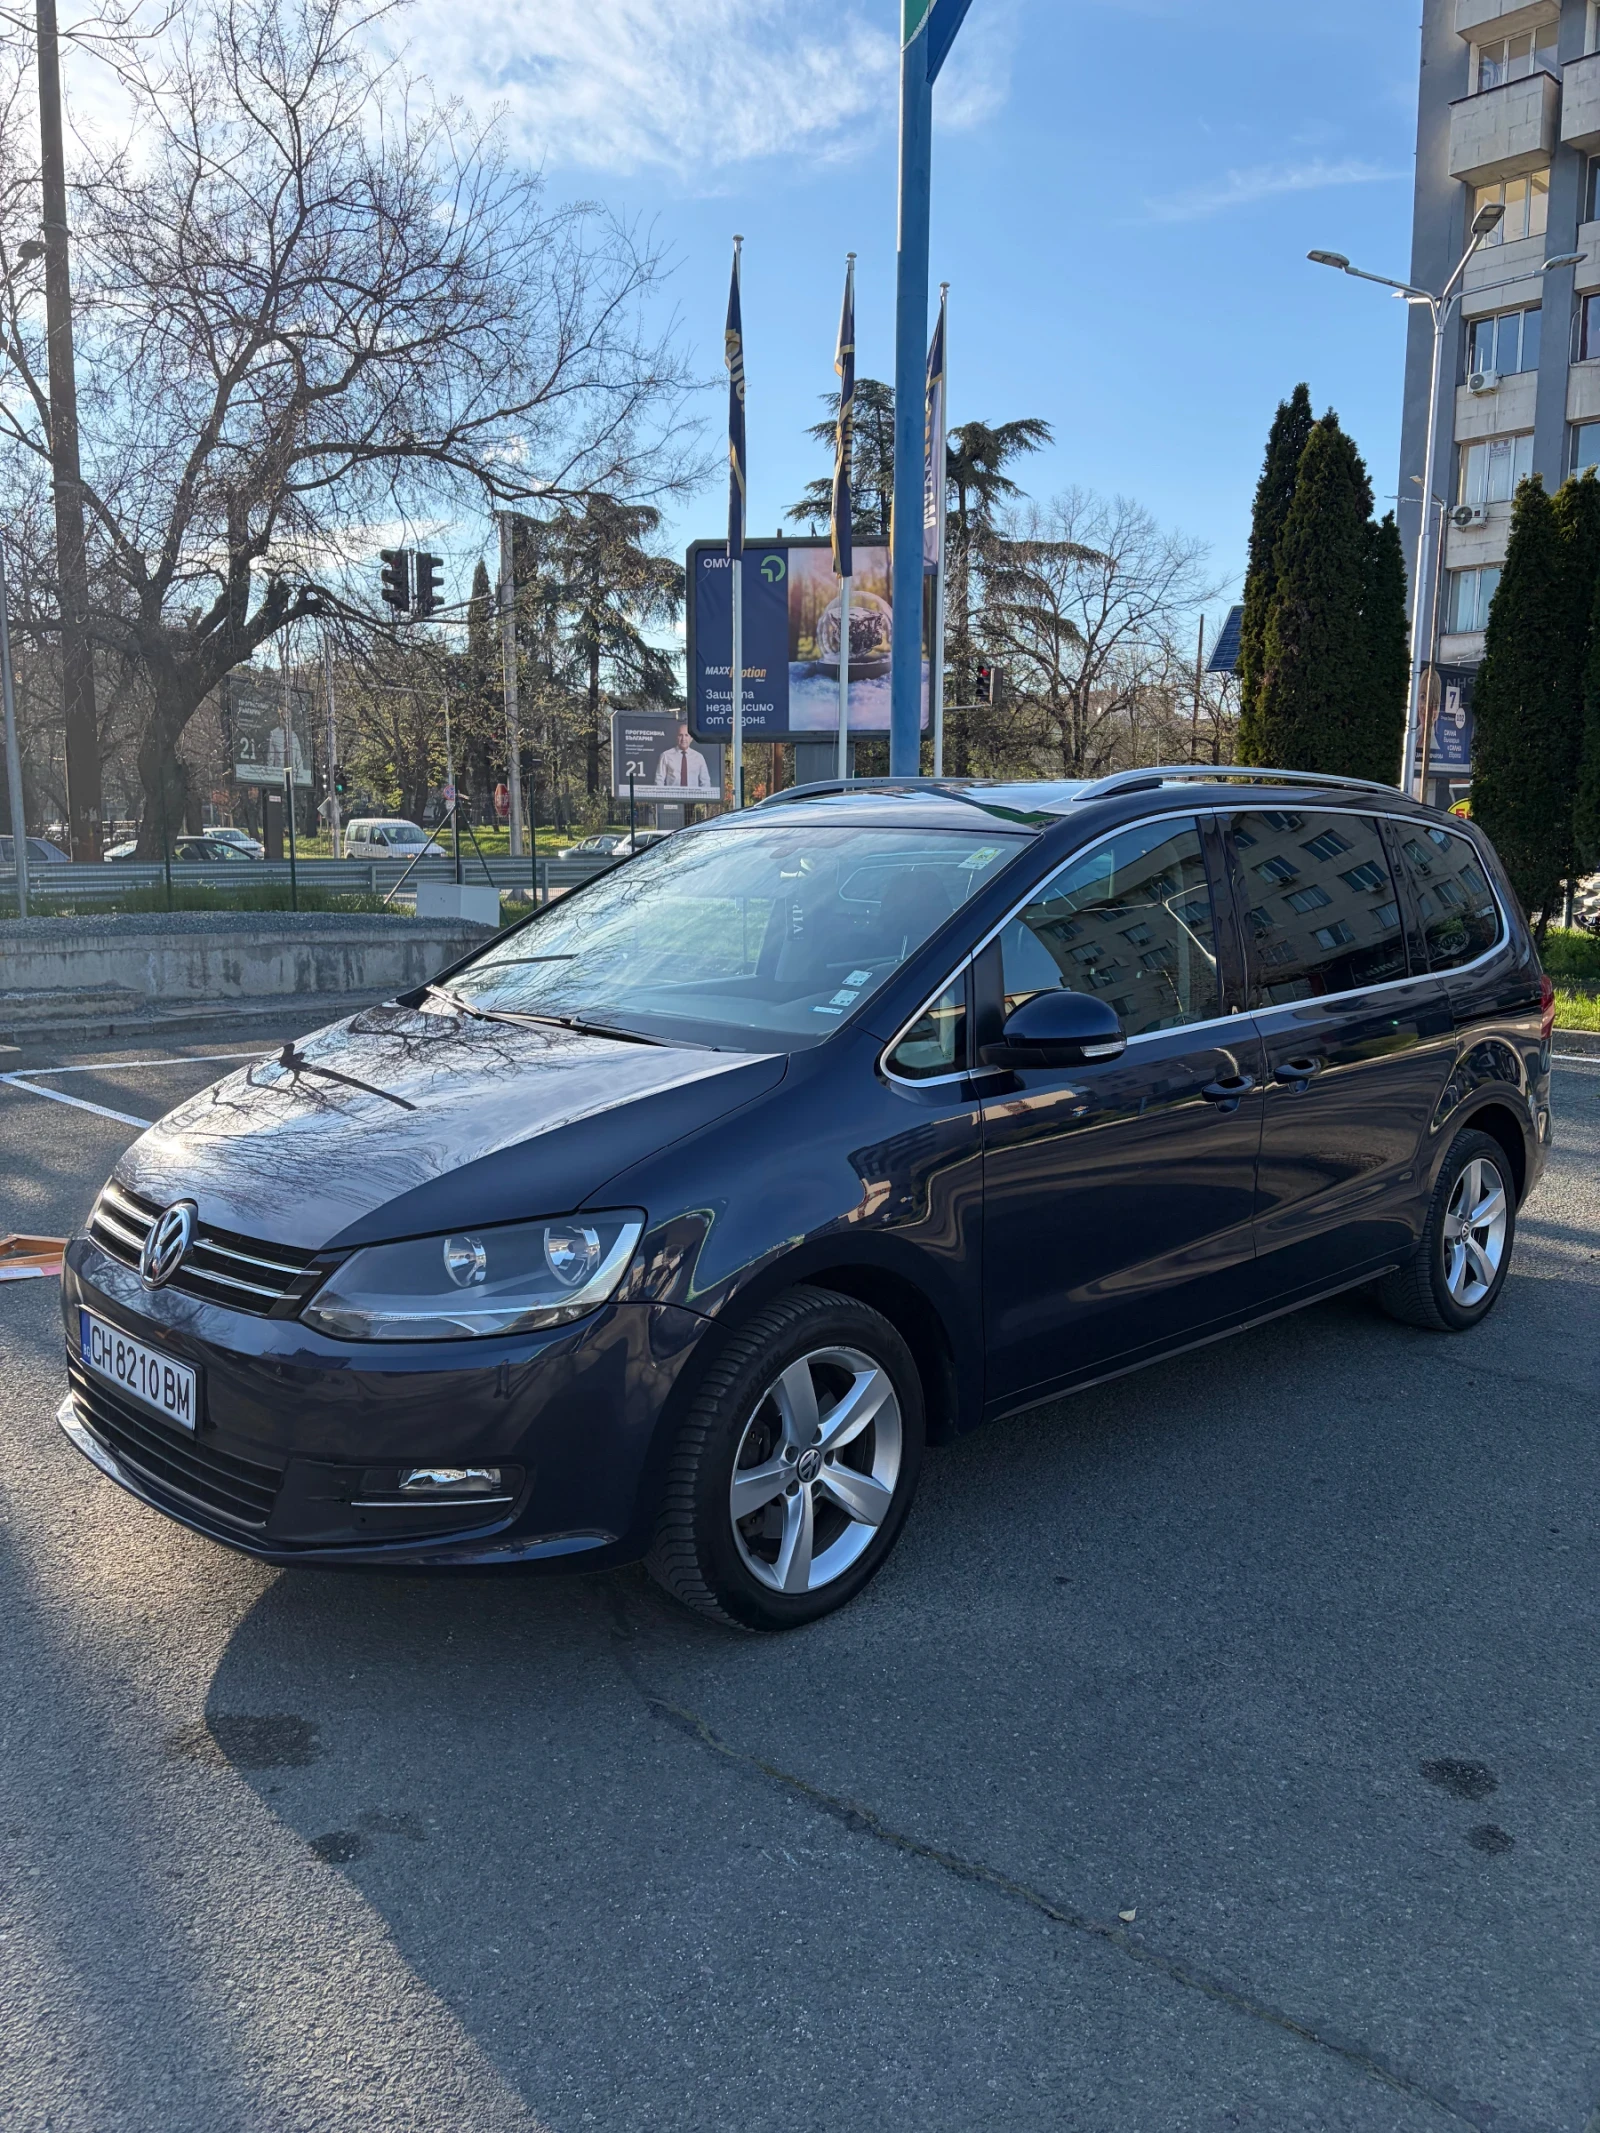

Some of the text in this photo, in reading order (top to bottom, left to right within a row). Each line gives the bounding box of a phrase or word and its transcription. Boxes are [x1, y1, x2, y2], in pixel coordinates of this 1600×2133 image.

[703, 558, 731, 569] OMV
[705, 666, 767, 678] MAXXotion
[705, 704, 774, 714] незаисимо
[706, 716, 766, 727] от сзона
[240, 737, 256, 760] 21
[625, 760, 646, 777] 21
[92, 1325, 190, 1421] CH 8210 BM
